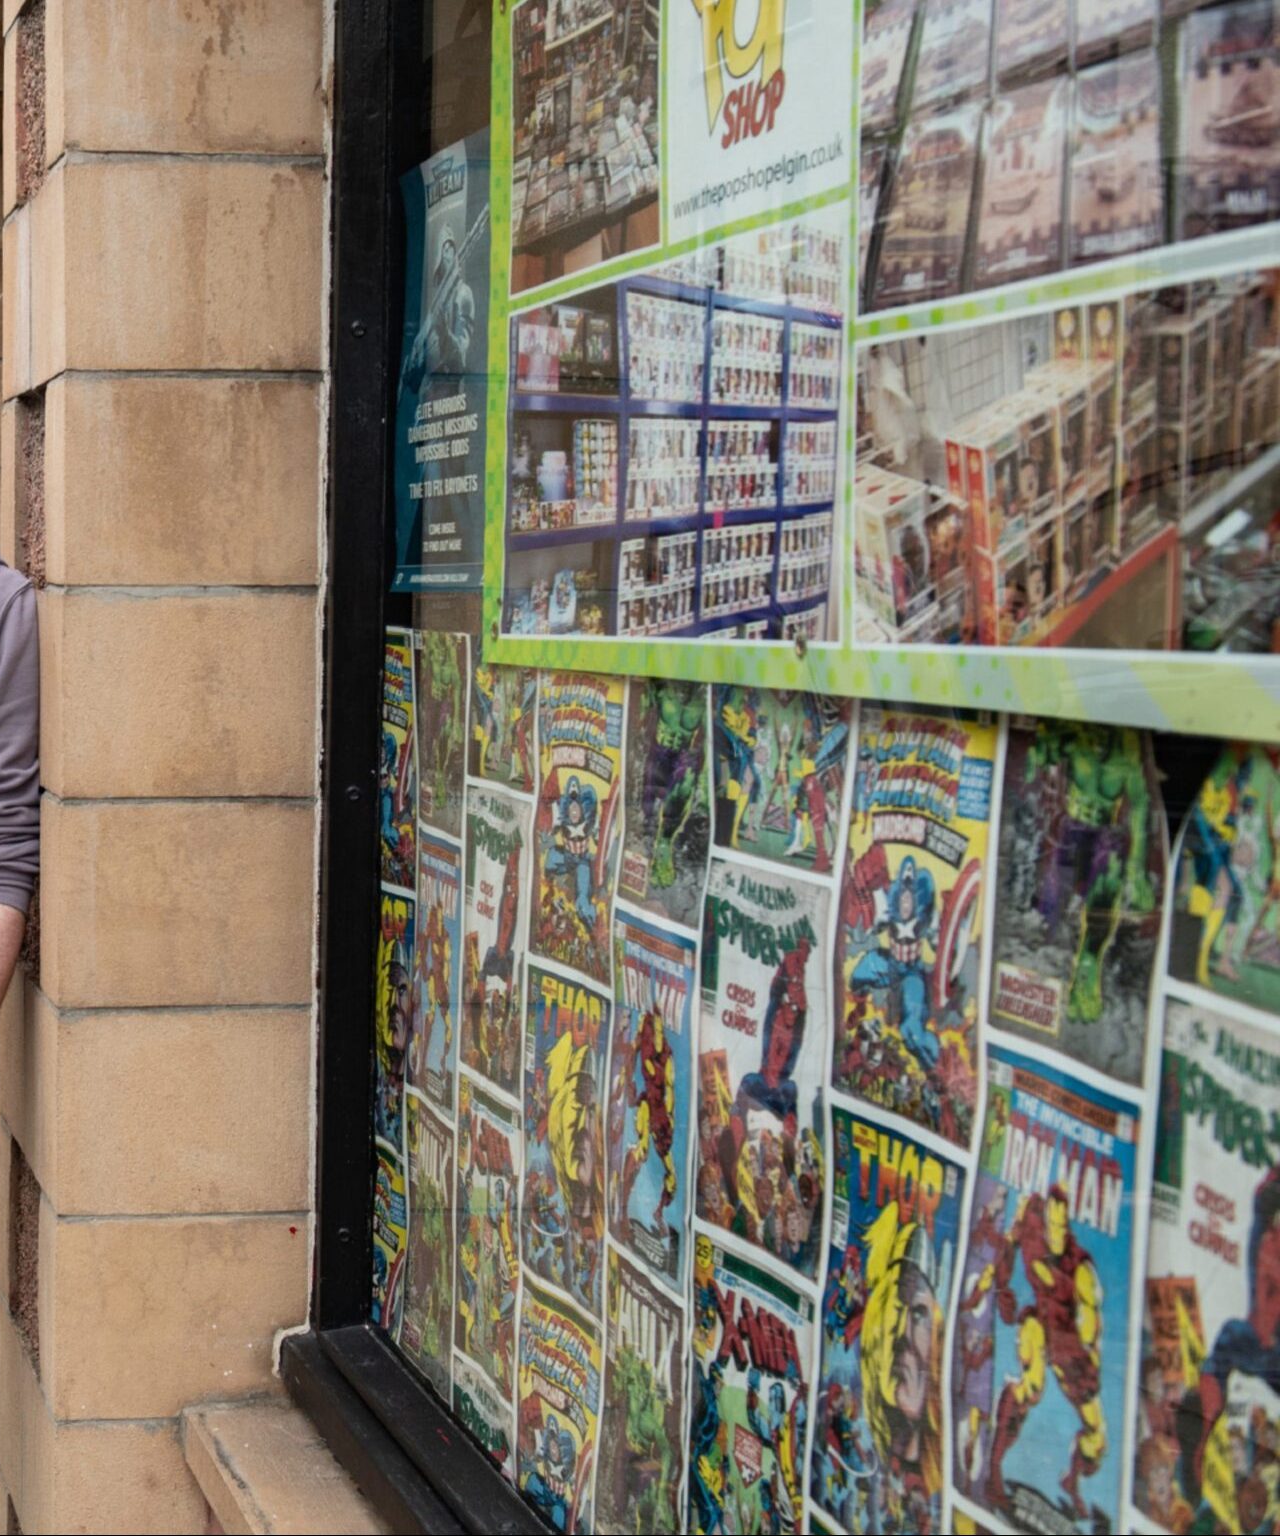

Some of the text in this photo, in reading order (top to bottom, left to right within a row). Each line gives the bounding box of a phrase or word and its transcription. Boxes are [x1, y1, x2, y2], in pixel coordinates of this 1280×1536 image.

[721, 69, 786, 150] SHOP
[674, 132, 844, 219] www.thepopshopelgin.co.uk
[408, 413, 478, 444] DANGEROUS MISSIONS
[433, 393, 466, 416] WARRIORS
[415, 441, 450, 463] IMPOSSIBLE
[877, 718, 969, 774] CAPTAIN
[870, 765, 959, 823] AMERICA
[737, 873, 796, 911] AMAZING
[1017, 1090, 1115, 1156] THE INVINCIBLE
[851, 1120, 944, 1242] THOR
[1000, 1110, 1124, 1239] IRON MAN
[708, 1277, 805, 1382] X-MEN
